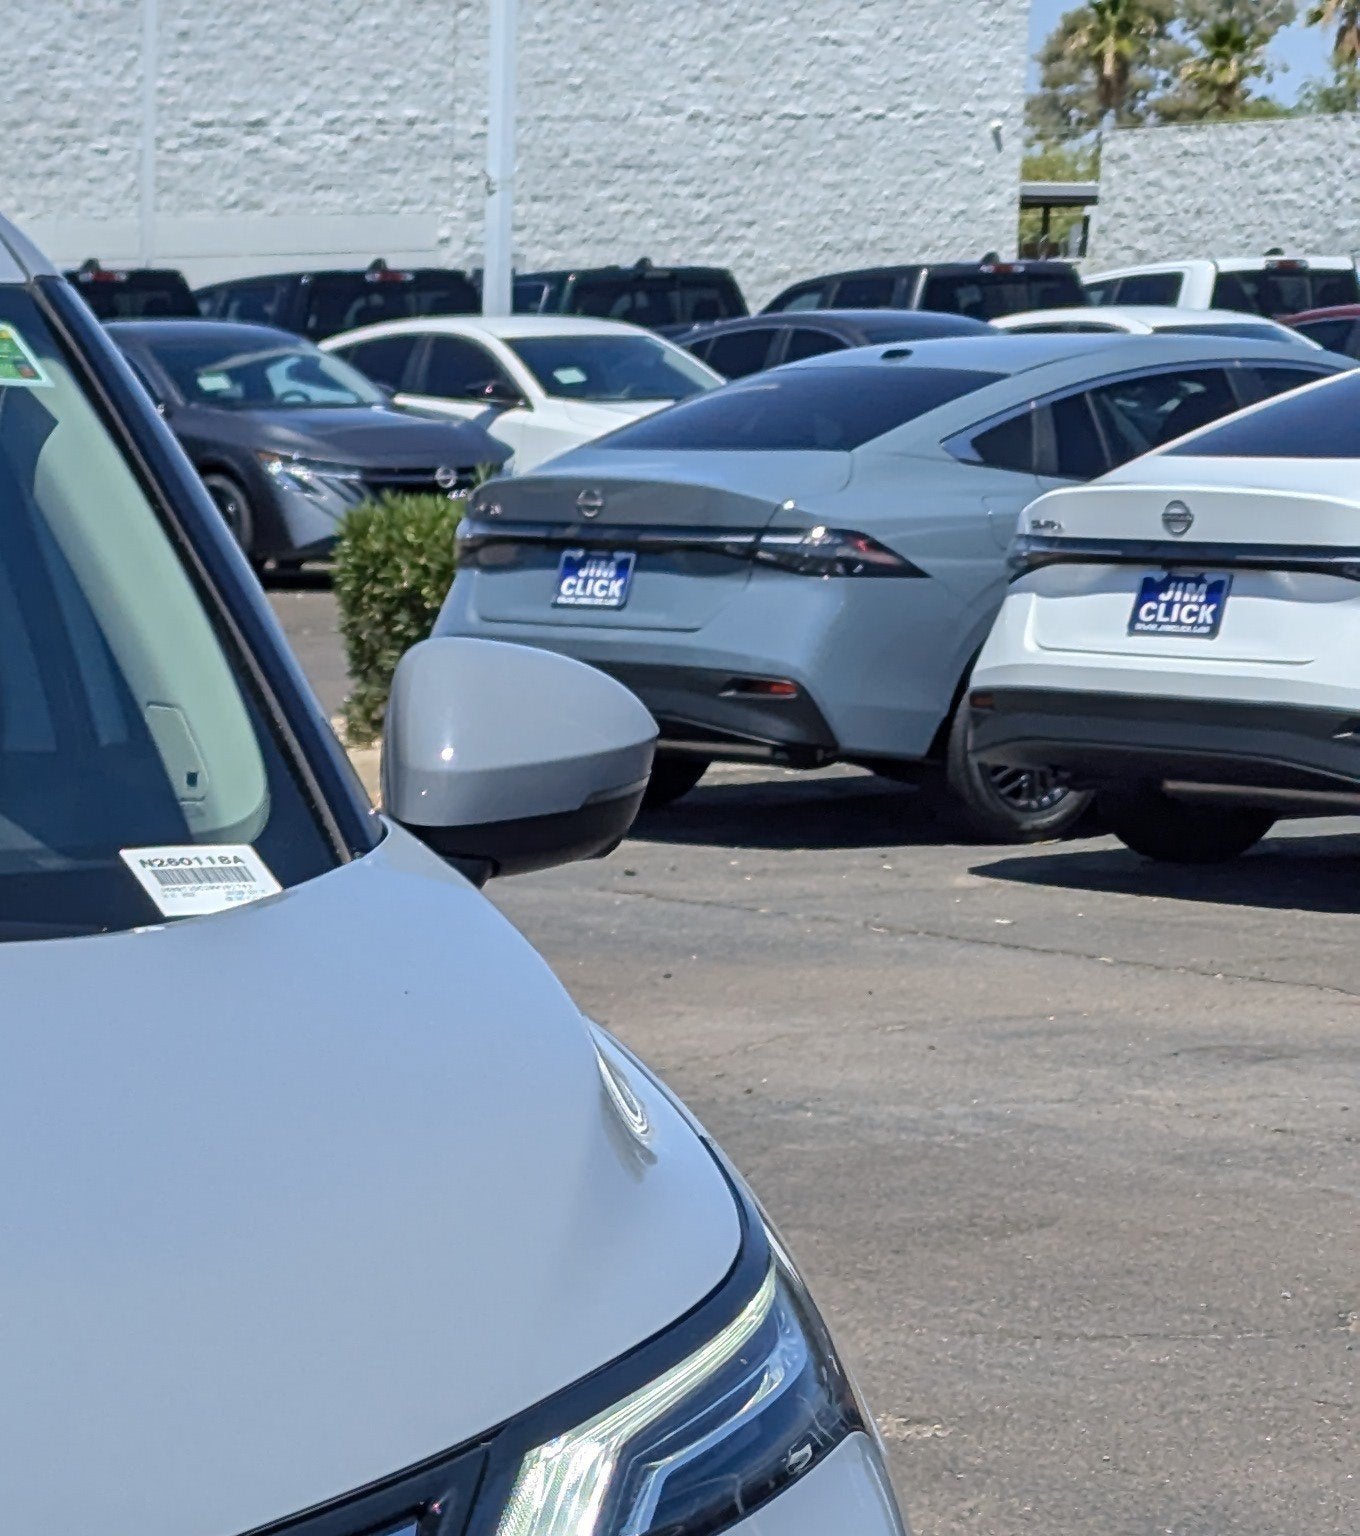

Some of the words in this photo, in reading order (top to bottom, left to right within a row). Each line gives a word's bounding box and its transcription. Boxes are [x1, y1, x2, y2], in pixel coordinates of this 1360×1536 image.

[560, 575, 625, 598] CLICK
[1158, 582, 1208, 602] JIM
[1138, 601, 1218, 624] CLICK
